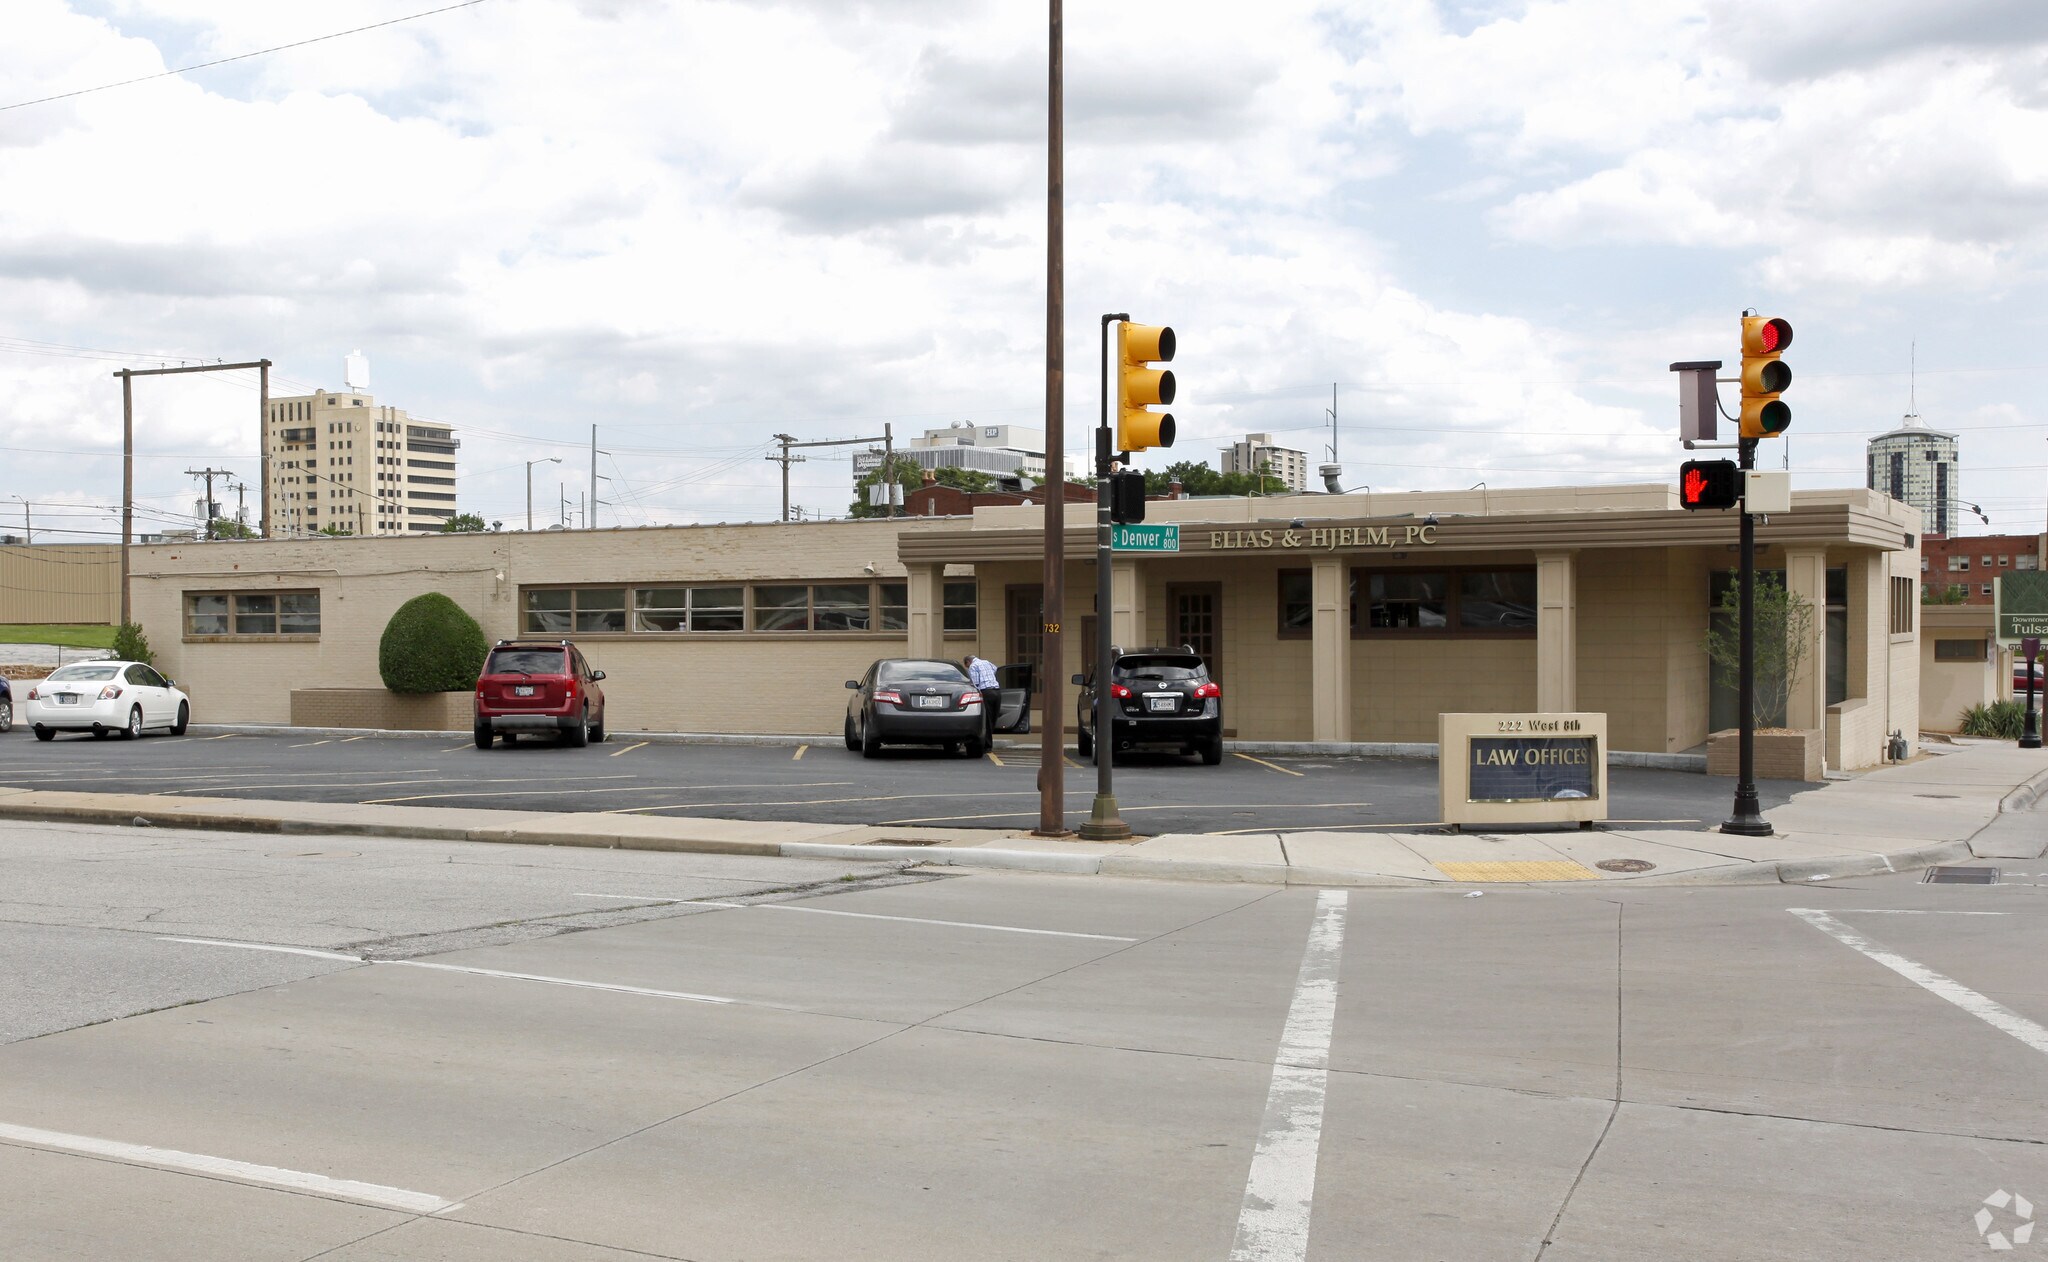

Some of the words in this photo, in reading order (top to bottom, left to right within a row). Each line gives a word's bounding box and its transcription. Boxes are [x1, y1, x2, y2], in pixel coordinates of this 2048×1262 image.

[986, 428, 997, 437] HP
[1113, 531, 1118, 543] S
[1121, 529, 1160, 546] Denver
[1165, 527, 1174, 538] AV
[1209, 529, 1274, 549] ELIAS
[1281, 528, 1302, 548] &
[1310, 527, 1397, 551] HJELM,
[1405, 525, 1438, 545] PC
[1163, 538, 1177, 549] 800
[1044, 623, 1060, 633] 732
[2011, 623, 2048, 634] Tulsa
[1498, 720, 1524, 732] 222
[1529, 720, 1560, 731] West
[1563, 719, 1581, 731] 8th
[1476, 748, 1519, 766] LAW
[1524, 748, 1588, 765] OFFICES
